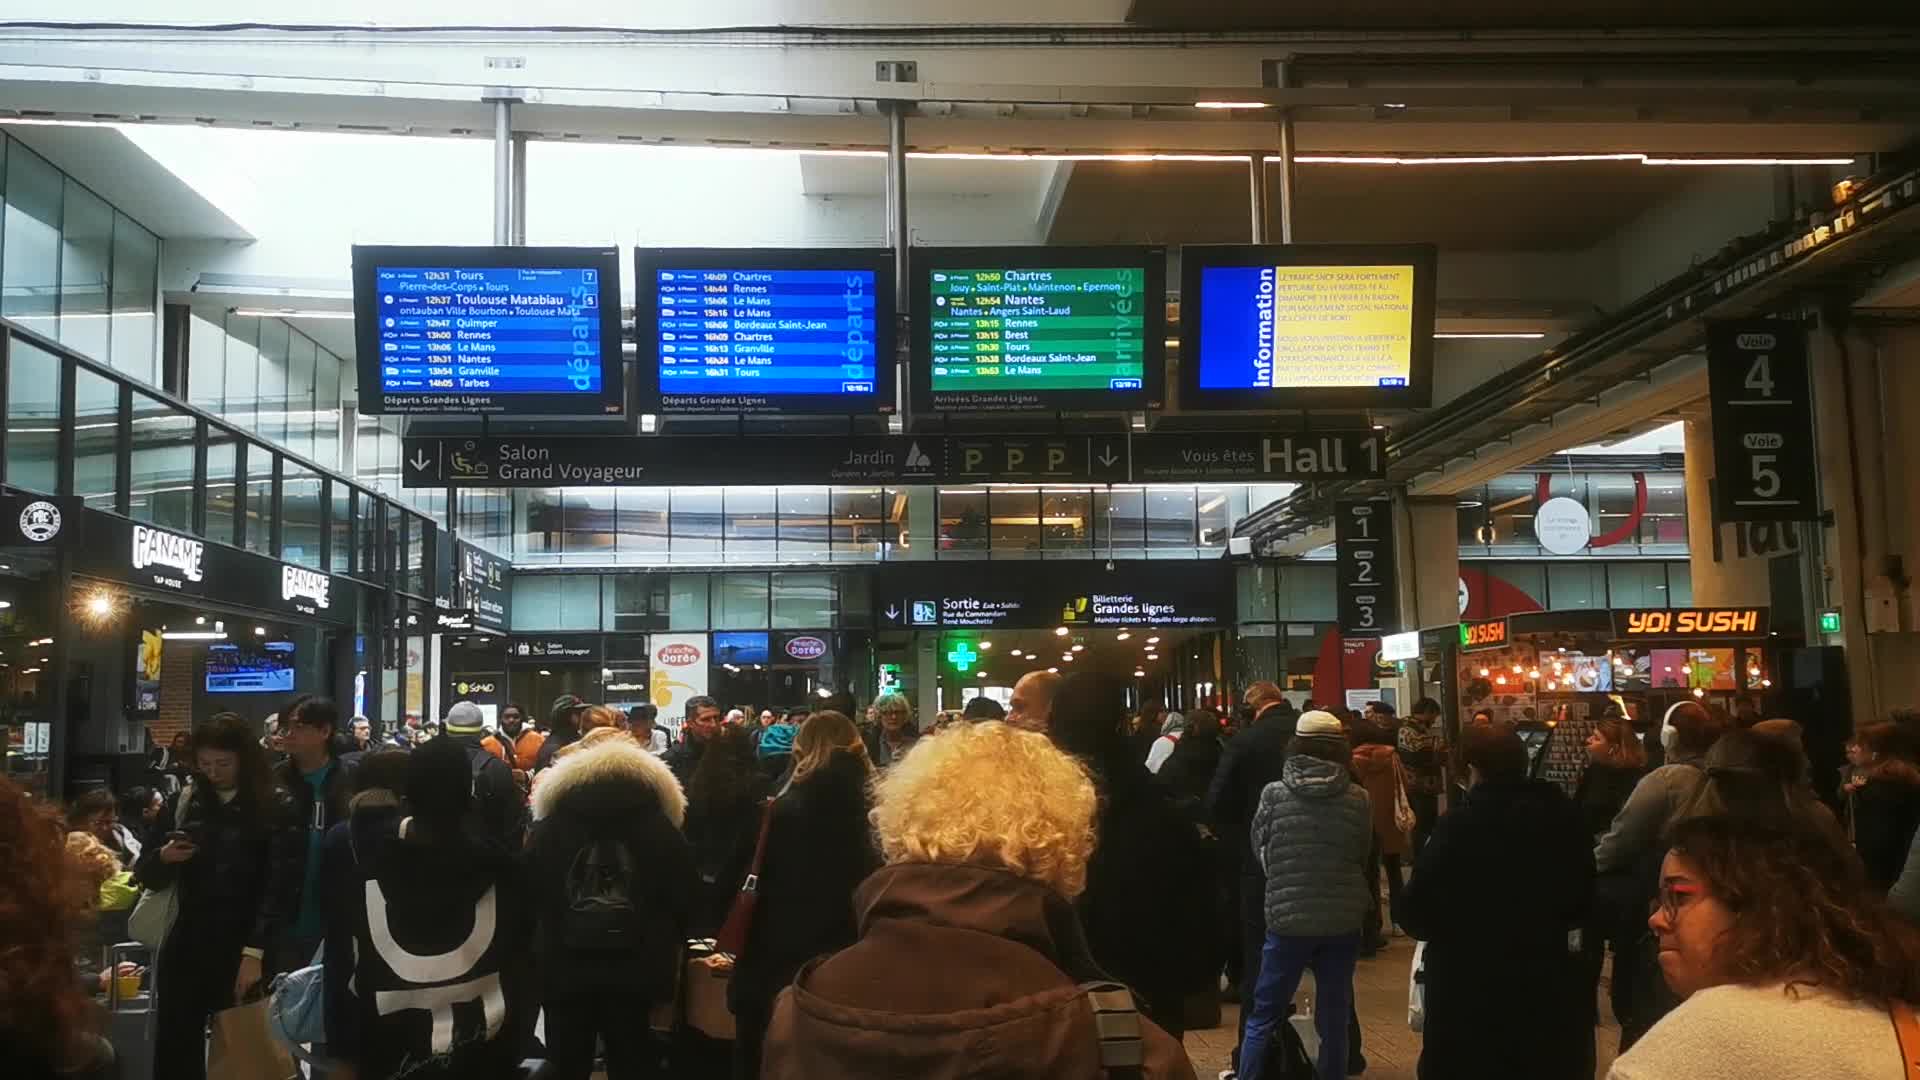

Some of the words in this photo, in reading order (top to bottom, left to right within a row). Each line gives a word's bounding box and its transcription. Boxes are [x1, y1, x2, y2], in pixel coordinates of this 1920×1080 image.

[454, 270, 484, 281] Tours
[586, 272, 593, 281] 7
[733, 271, 772, 281] Chartres
[1004, 270, 1052, 281] Chartres
[485, 282, 509, 291] Tours
[733, 283, 767, 294] Rennes
[950, 283, 970, 294] Jouy
[1028, 282, 1076, 292] Maintenon
[456, 293, 508, 305] Toulouse
[510, 294, 564, 305] Matabiau
[734, 296, 745, 306] Le
[746, 296, 771, 306] Mans
[1005, 295, 1045, 305] Nantes
[445, 306, 467, 315] Ville
[469, 306, 508, 316] Bourbon
[515, 306, 556, 316] Toulouse
[734, 308, 745, 318] Le
[747, 308, 771, 318] Mans
[951, 307, 983, 316] Nantes
[989, 307, 1020, 317] Angers
[1022, 307, 1070, 316] Saint-Laud
[456, 318, 499, 329] Quimper
[734, 320, 776, 330] Bordeaux
[778, 320, 827, 330] Saint-Jean
[841, 275, 870, 379] départs
[1005, 318, 1038, 328] Rennes
[1110, 270, 1133, 377] arrivées
[1253, 268, 1273, 388] Information
[457, 330, 491, 340] Rennes
[568, 286, 595, 390] départs
[734, 331, 773, 342] Chartres
[1005, 330, 1029, 340] Brest
[458, 342, 469, 352] Le
[471, 342, 496, 352] Mans
[734, 343, 775, 354] Granville
[1005, 342, 1030, 352] Tours
[458, 354, 492, 364] Nantes
[734, 355, 746, 365] Le
[747, 355, 772, 366] Mans
[1005, 353, 1047, 363] Bordeaux
[1049, 353, 1096, 362] Saint-Jean
[458, 366, 500, 376] Granville
[735, 367, 760, 377] Tours
[1005, 365, 1016, 375] Le
[1017, 365, 1042, 375] Mans
[1744, 355, 1775, 397] 4
[460, 378, 490, 388] Tarbes
[384, 396, 420, 406] Départs
[422, 396, 460, 405] Grandes
[462, 396, 491, 406] Lignes
[662, 396, 698, 406] Départs
[700, 396, 736, 405] Grandes
[738, 396, 766, 406] Lignes
[1748, 436, 1778, 448] Voie
[499, 444, 549, 460] Salon
[843, 449, 895, 465] Jardin
[1182, 450, 1217, 462] Vous
[1223, 449, 1255, 462] êtes
[1262, 438, 1347, 473] Hall
[1360, 437, 1378, 473] 1
[499, 463, 553, 480] Grand
[558, 463, 644, 482] Voyageur
[1751, 455, 1781, 498] 5
[1356, 517, 1369, 538] 1
[132, 525, 204, 582] PANAME
[1357, 561, 1373, 582] 2
[282, 565, 330, 609] PANAME
[943, 597, 980, 610] Sortie
[1093, 594, 1134, 604] Billetterie
[943, 610, 955, 618] Rue
[1093, 603, 1140, 614] Grandes
[1142, 602, 1175, 616] lignes
[1359, 605, 1374, 628] 3
[1628, 612, 1671, 633] YO!
[1676, 611, 1757, 632] SUSHI
[1478, 622, 1505, 643] SUSHI
